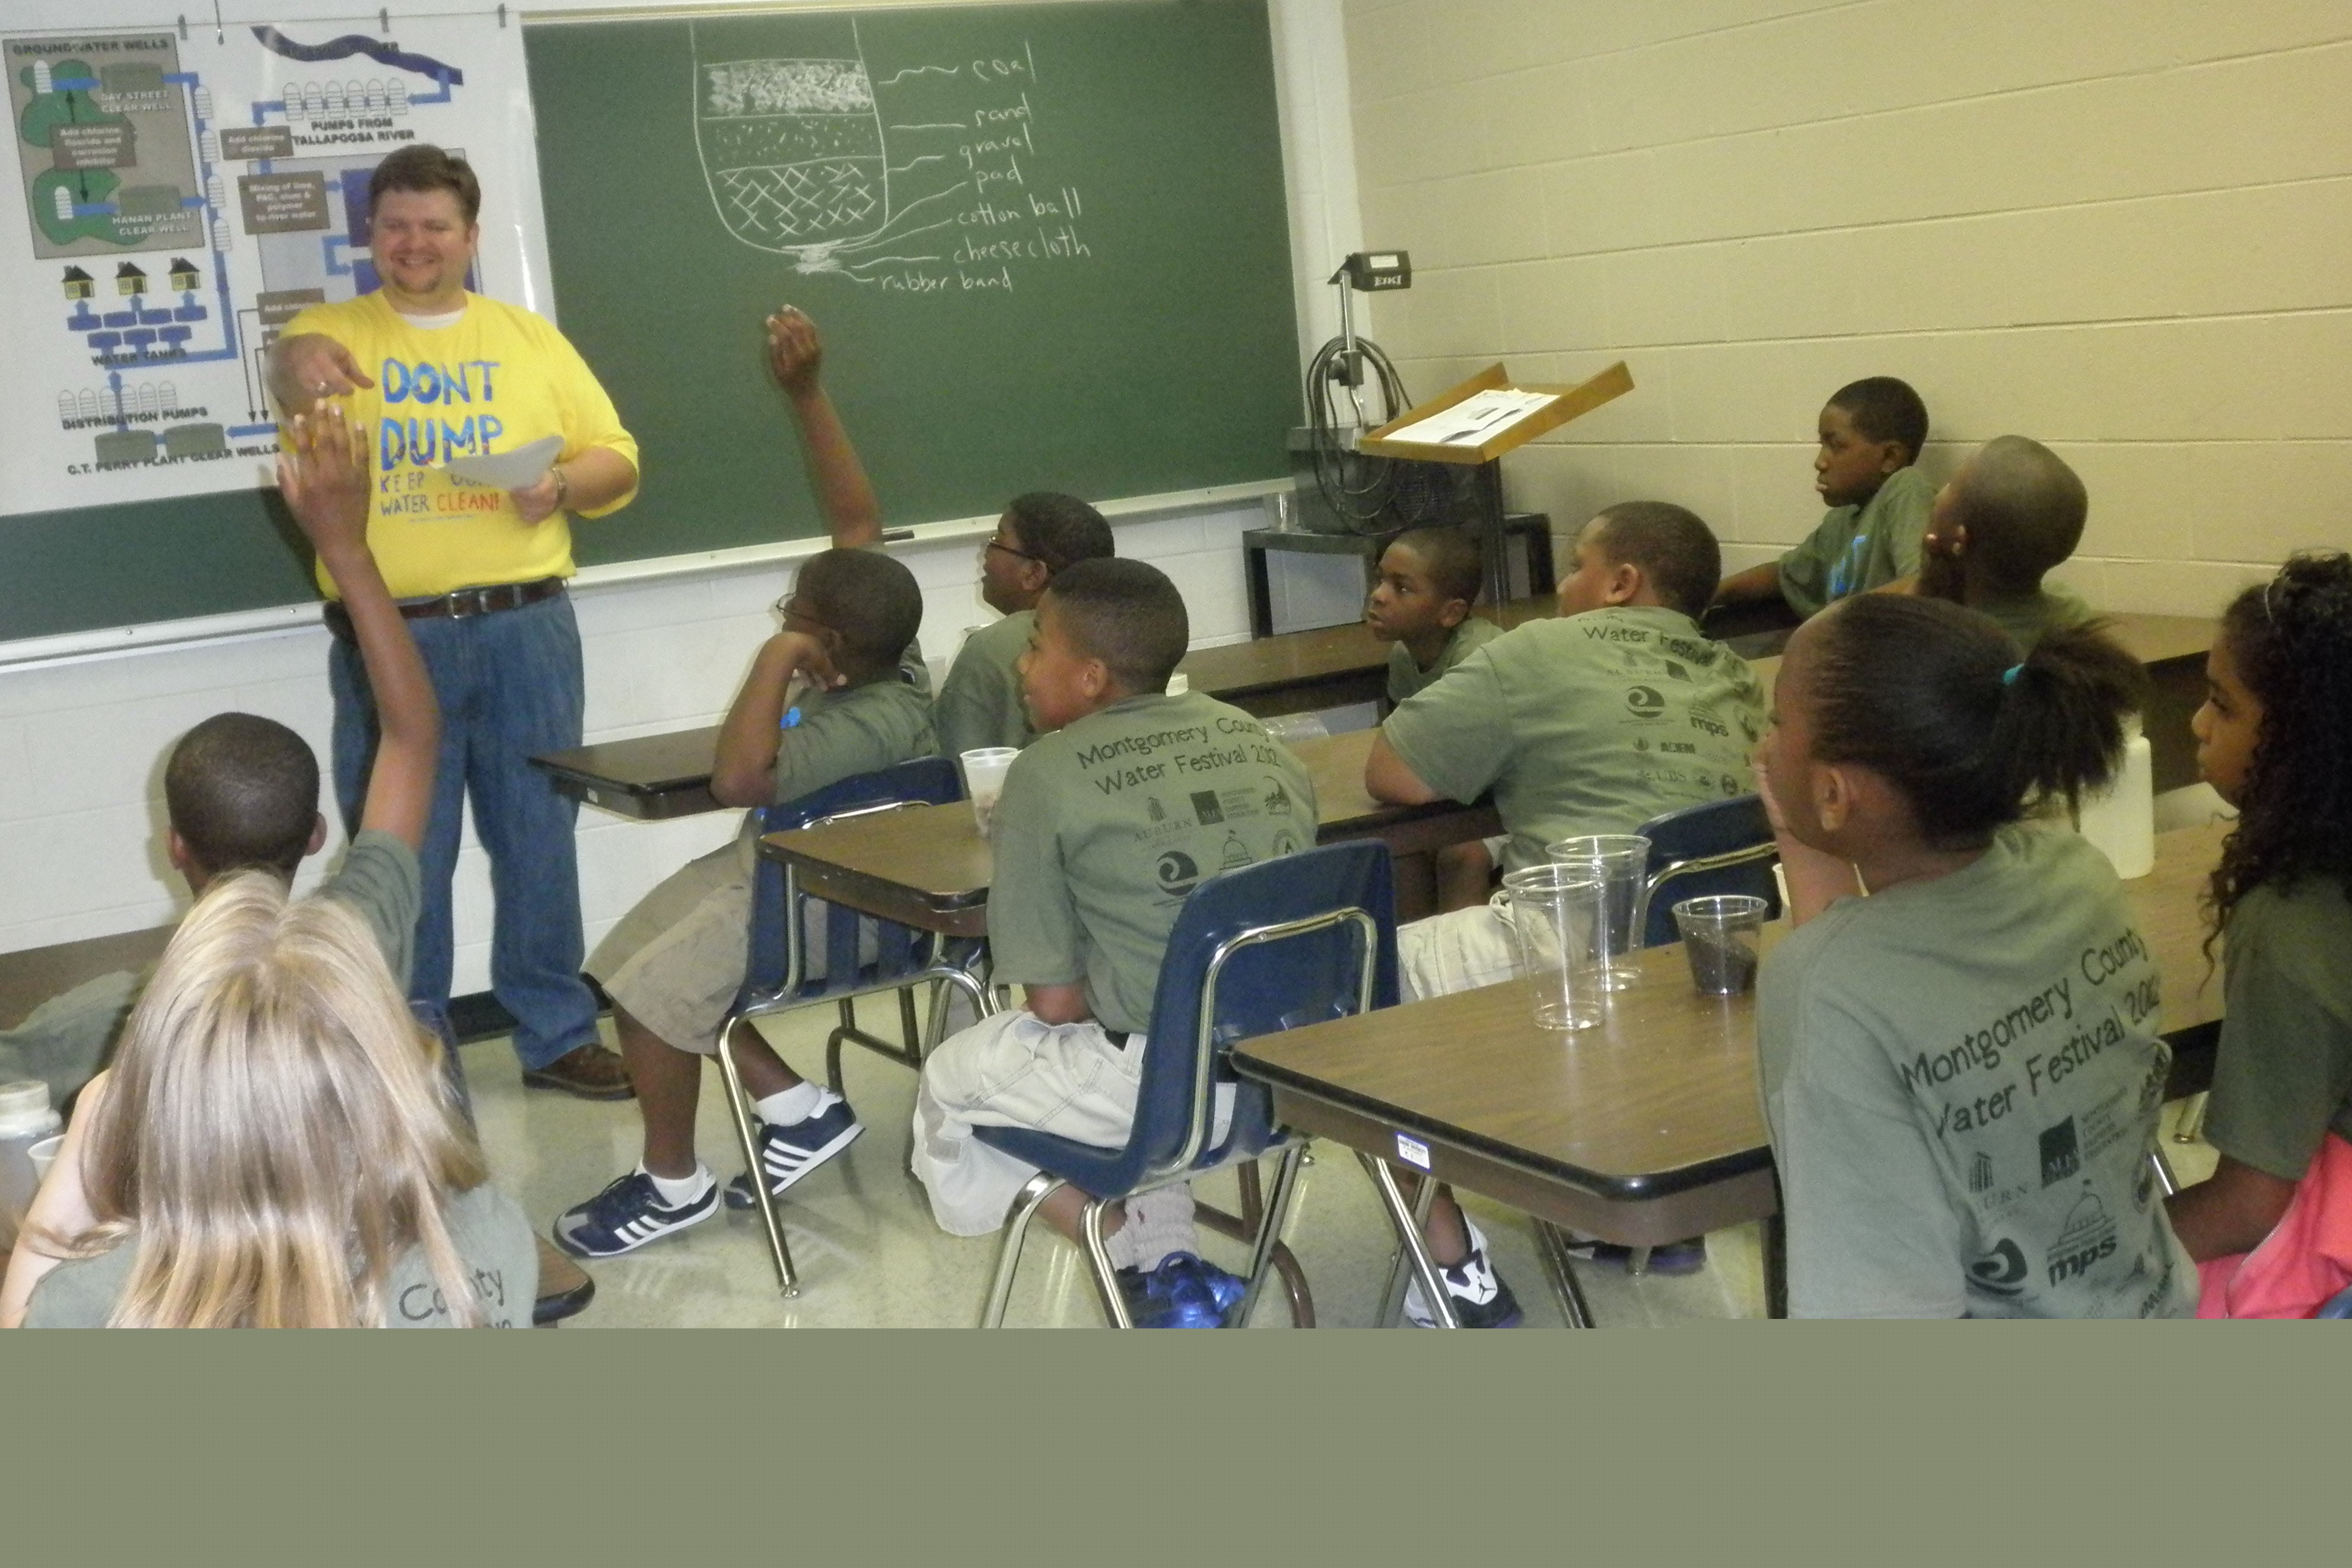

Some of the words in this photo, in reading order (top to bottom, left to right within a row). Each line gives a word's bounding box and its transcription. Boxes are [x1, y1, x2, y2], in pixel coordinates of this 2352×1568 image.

[123, 39, 168, 50] WELLS
[973, 40, 1036, 83] coal
[101, 104, 138, 113] CLEAR
[142, 102, 170, 111] WELL
[291, 132, 374, 146] TALLAPOOSA
[377, 129, 415, 141] RIVER
[311, 119, 354, 132] PUMPS
[358, 117, 393, 129] FROM
[959, 122, 1035, 170] gravel
[976, 153, 1023, 193] pad
[155, 211, 192, 221] PLANT
[957, 200, 1022, 226] cotton
[1028, 186, 1082, 219] ball
[119, 226, 156, 236] CLEAR
[159, 223, 190, 234] WELL
[881, 269, 949, 292] rubber
[959, 266, 1013, 293] band
[91, 352, 140, 366] WATER
[62, 410, 160, 430] DISTRIBUTION
[163, 406, 208, 421] PUMPS
[380, 413, 504, 471] DUMP
[94, 458, 141, 472] PERRY
[142, 454, 186, 467] PLANT
[189, 449, 233, 463] CLEAR
[235, 444, 280, 457] WELLS
[379, 472, 425, 493] KEEP
[380, 494, 429, 516] WATER
[1583, 626, 1650, 643] Water
[1077, 726, 1208, 770] Montgomery
[1095, 763, 1165, 795] Water
[1174, 743, 1247, 774] Festival
[1901, 977, 2073, 1095] Montgomery
[2025, 1005, 2127, 1097] Festival
[2048, 1235, 2117, 1287] mps
[399, 1268, 504, 1321] Coty
